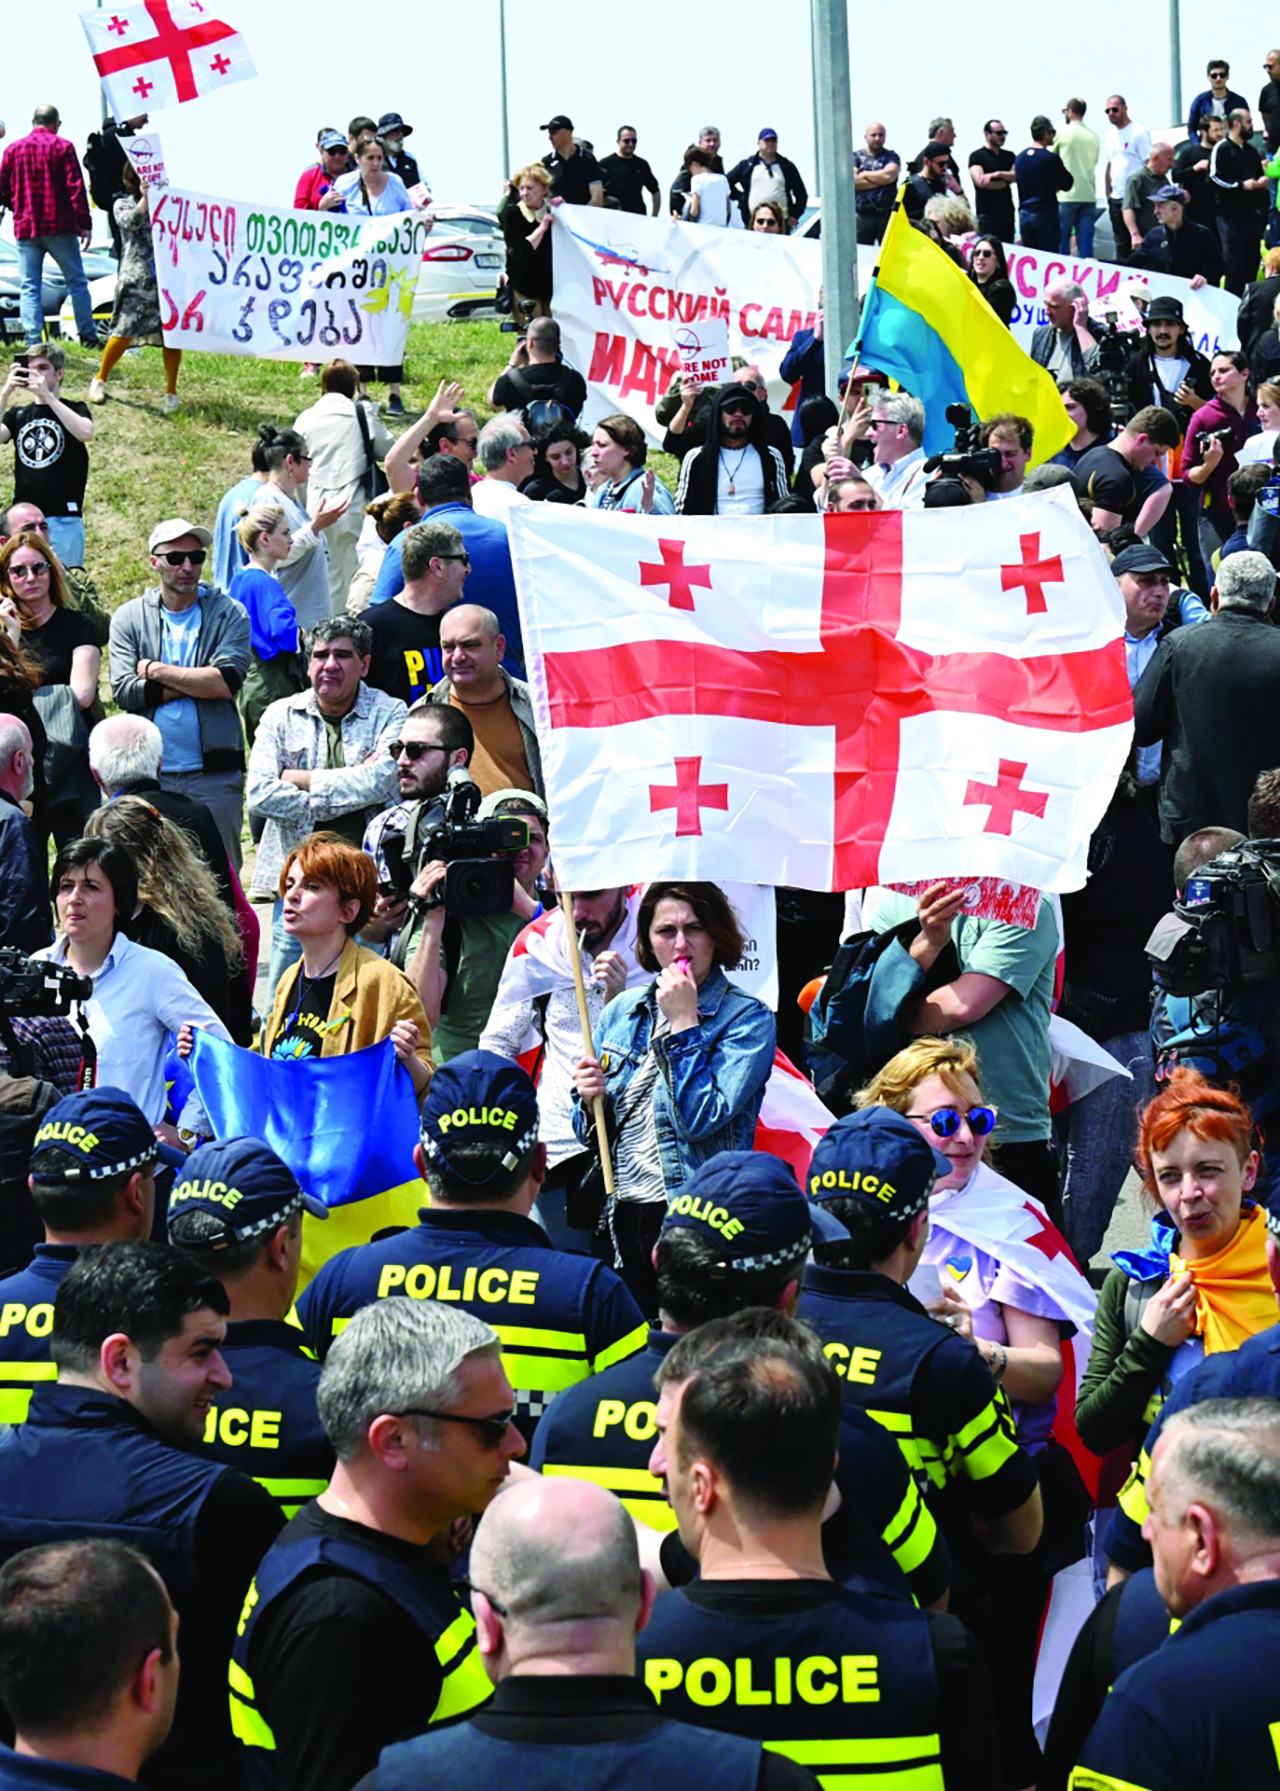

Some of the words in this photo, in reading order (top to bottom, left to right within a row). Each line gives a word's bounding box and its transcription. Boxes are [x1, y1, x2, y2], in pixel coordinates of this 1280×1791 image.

[591, 274, 731, 328] РУССКИЙ
[702, 357, 727, 371] NOT
[438, 1106, 519, 1134] POLICE
[33, 1121, 100, 1154] POLICE
[169, 1179, 244, 1211] POLICE
[810, 1170, 897, 1203] POLICE
[667, 1194, 745, 1241] POLICE
[377, 1263, 540, 1305] POLICE
[644, 1655, 881, 1707] POLICE
